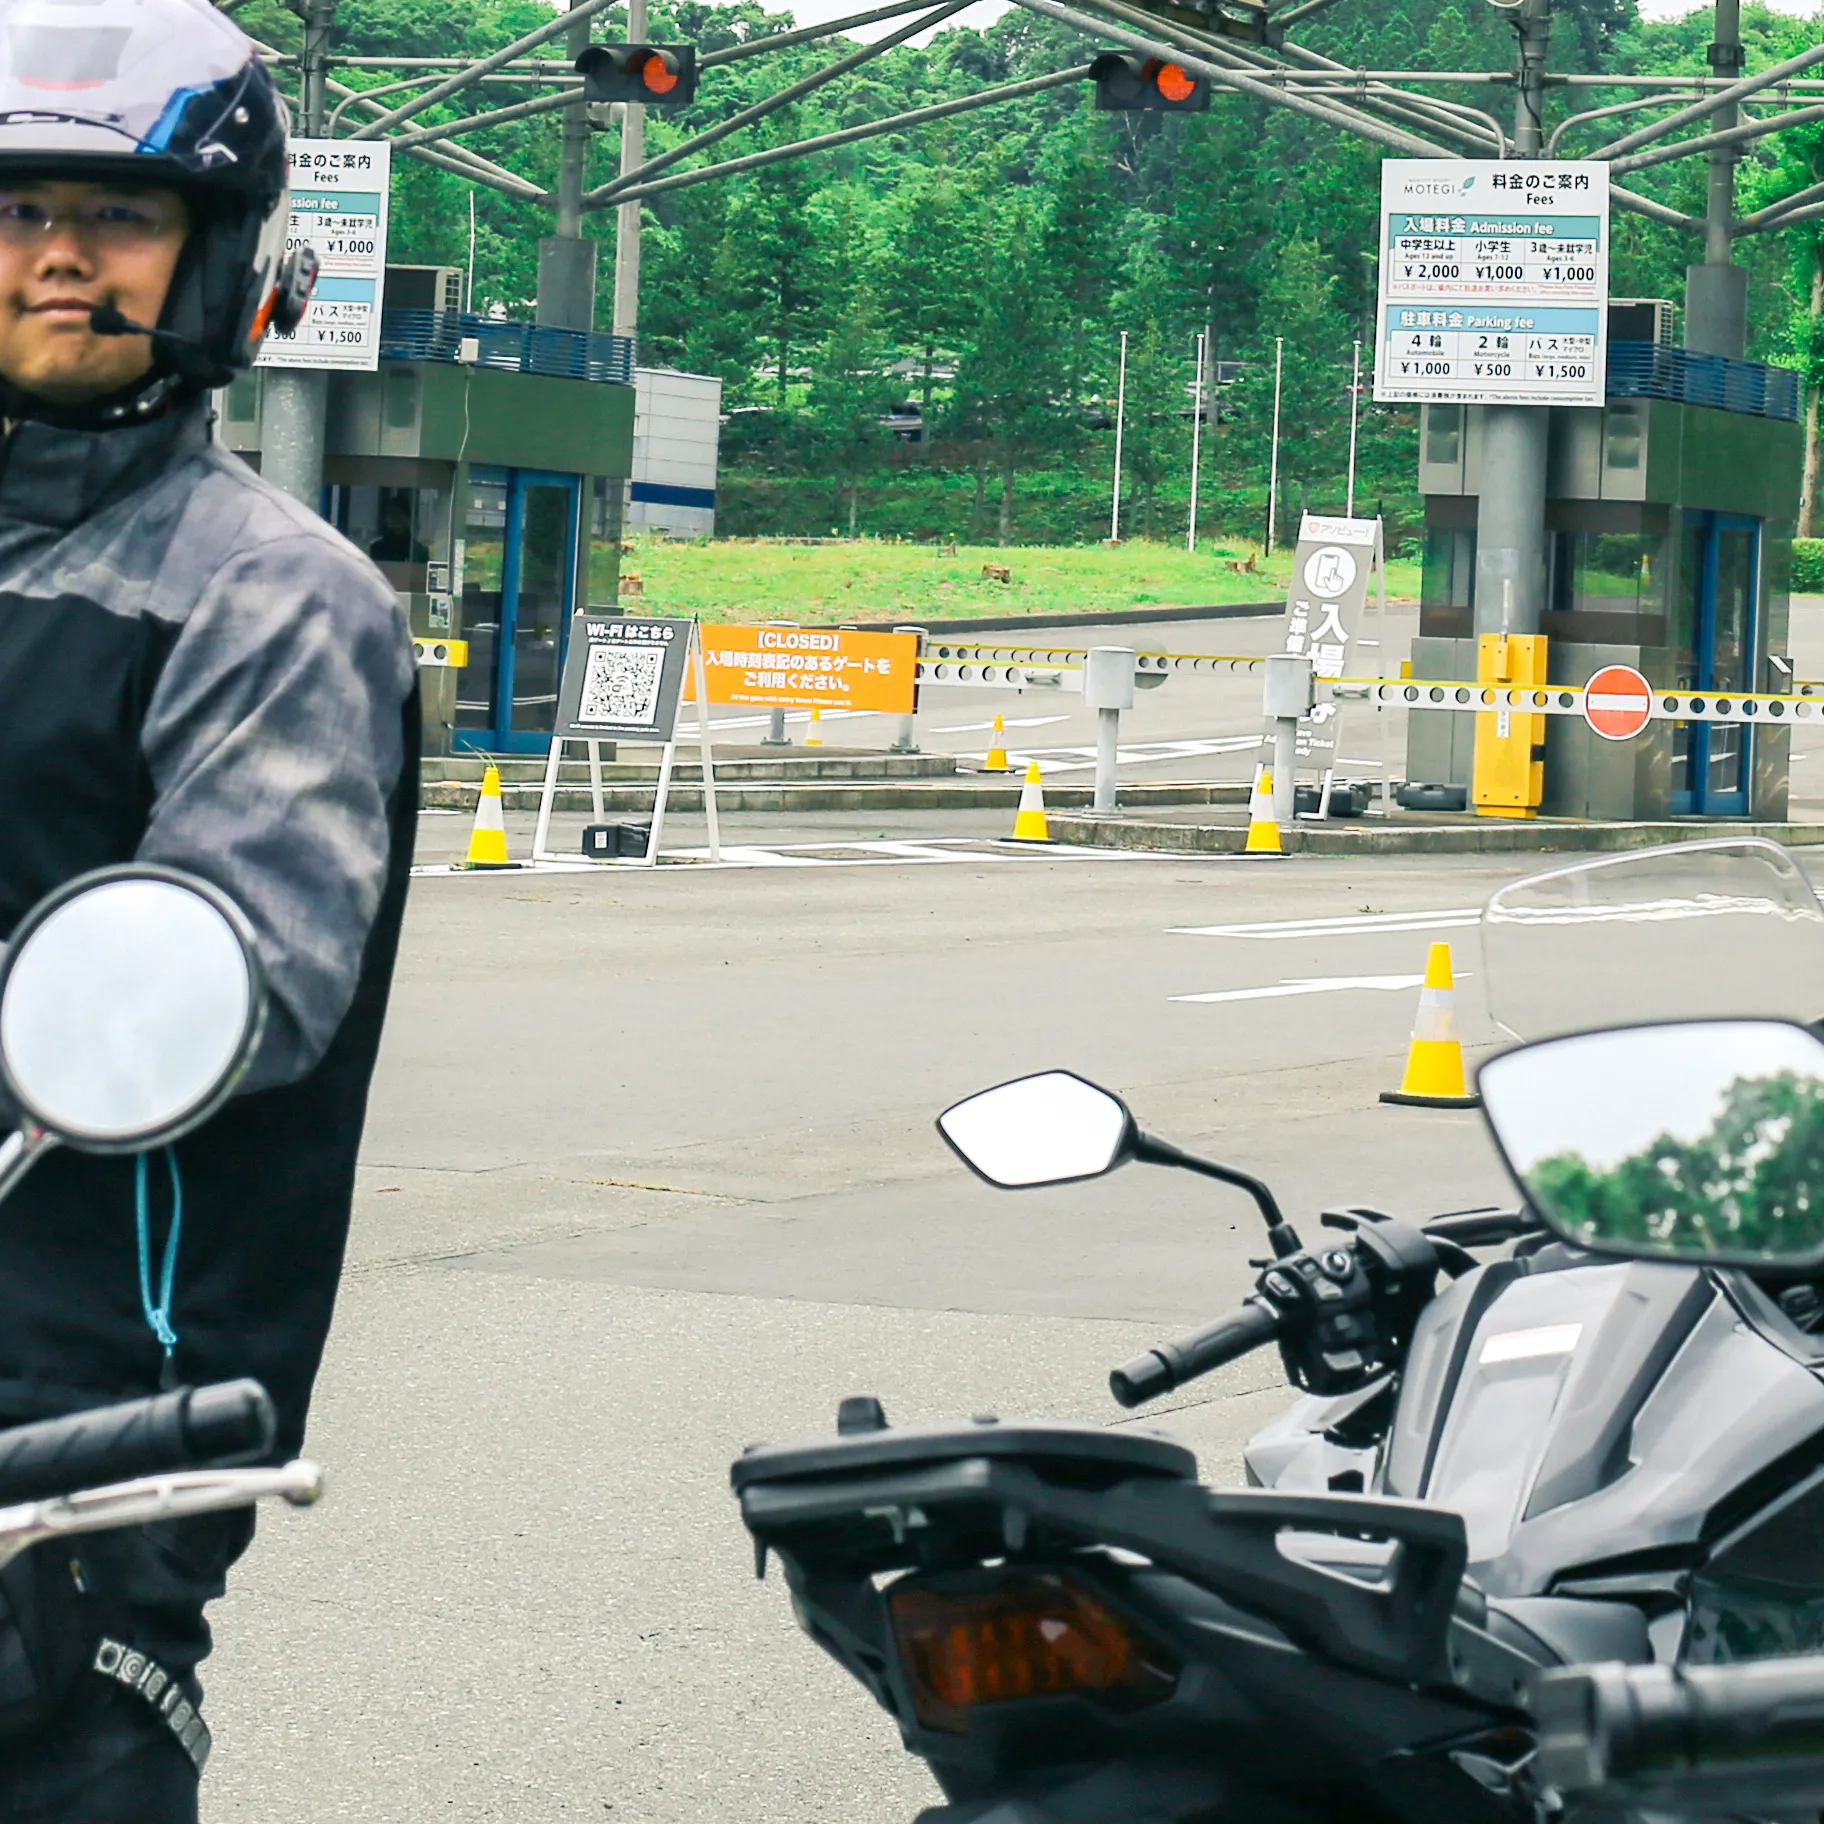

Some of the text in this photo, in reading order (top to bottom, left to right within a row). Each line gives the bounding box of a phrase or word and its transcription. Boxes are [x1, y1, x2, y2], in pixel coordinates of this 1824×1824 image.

[314, 171, 339, 183] Fees
[1492, 174, 1589, 190] 料金のご案内
[1404, 184, 1455, 195] MOTEGI
[320, 197, 339, 209] fee
[1527, 193, 1554, 204] Fees
[1404, 217, 1466, 234] 入場料金
[1470, 221, 1554, 234] Admission fee
[1401, 239, 1455, 251] 中学生以上
[1475, 241, 1511, 252] 小学生
[1476, 266, 1523, 281] ¥1,000
[1543, 267, 1594, 282] ¥1,000
[1467, 315, 1534, 330] Parking fee
[1308, 738, 1334, 749] Ticket
